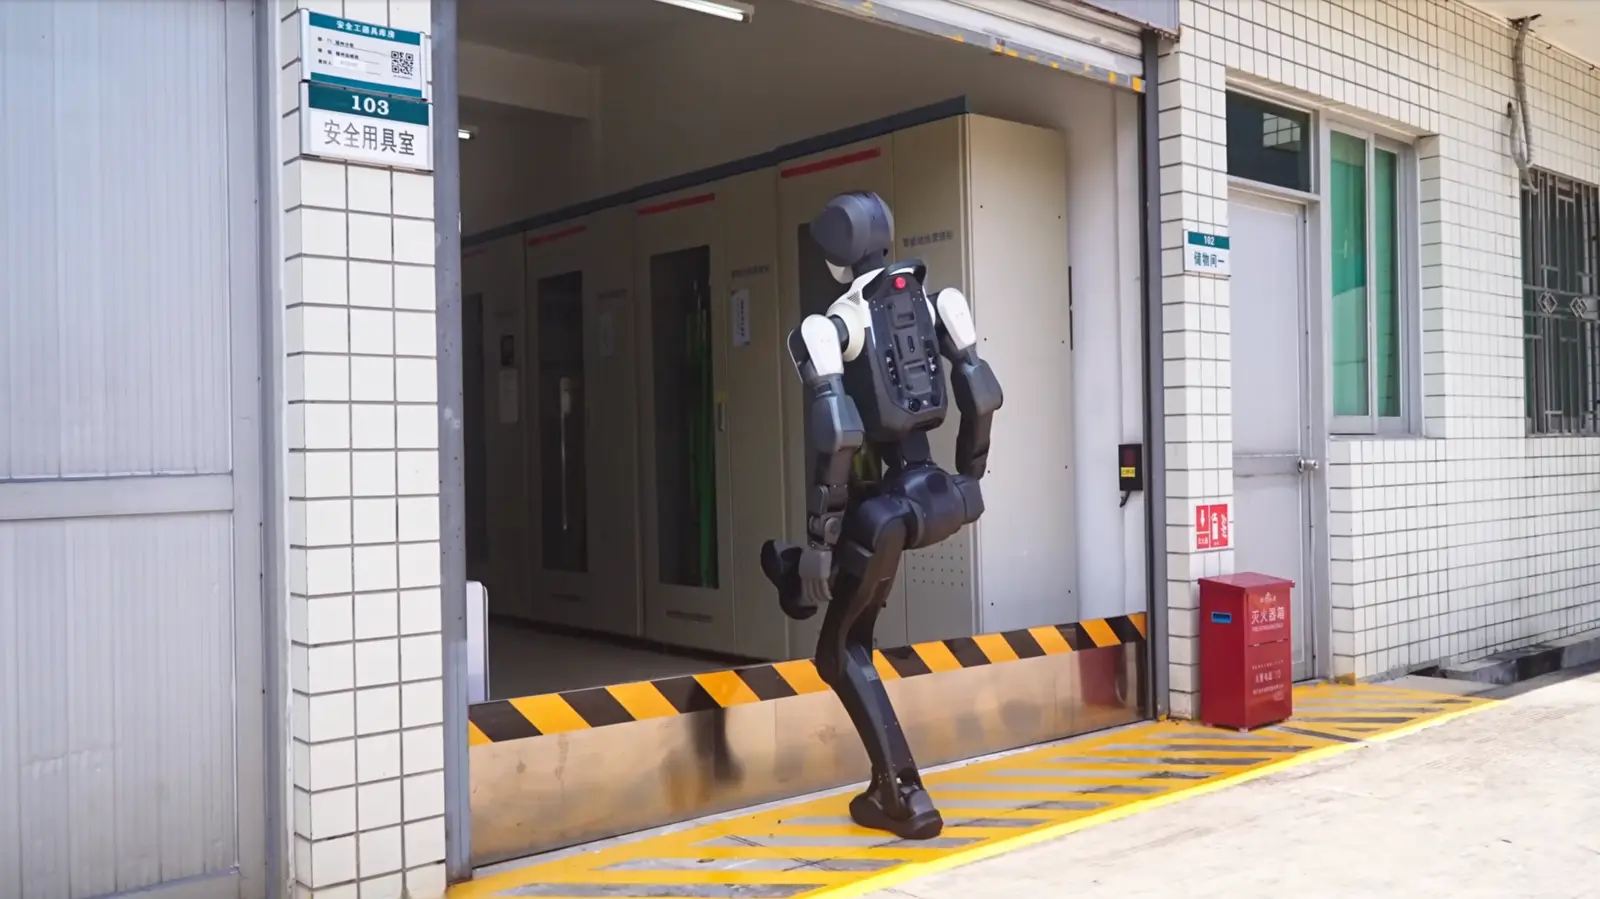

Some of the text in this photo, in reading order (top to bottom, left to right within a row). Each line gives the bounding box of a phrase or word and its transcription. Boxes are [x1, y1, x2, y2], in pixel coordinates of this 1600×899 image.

[352, 95, 390, 116] 103
[324, 119, 415, 156] 安全用具室
[1203, 235, 1216, 246] 102
[1251, 606, 1285, 625] 灭火器箱
